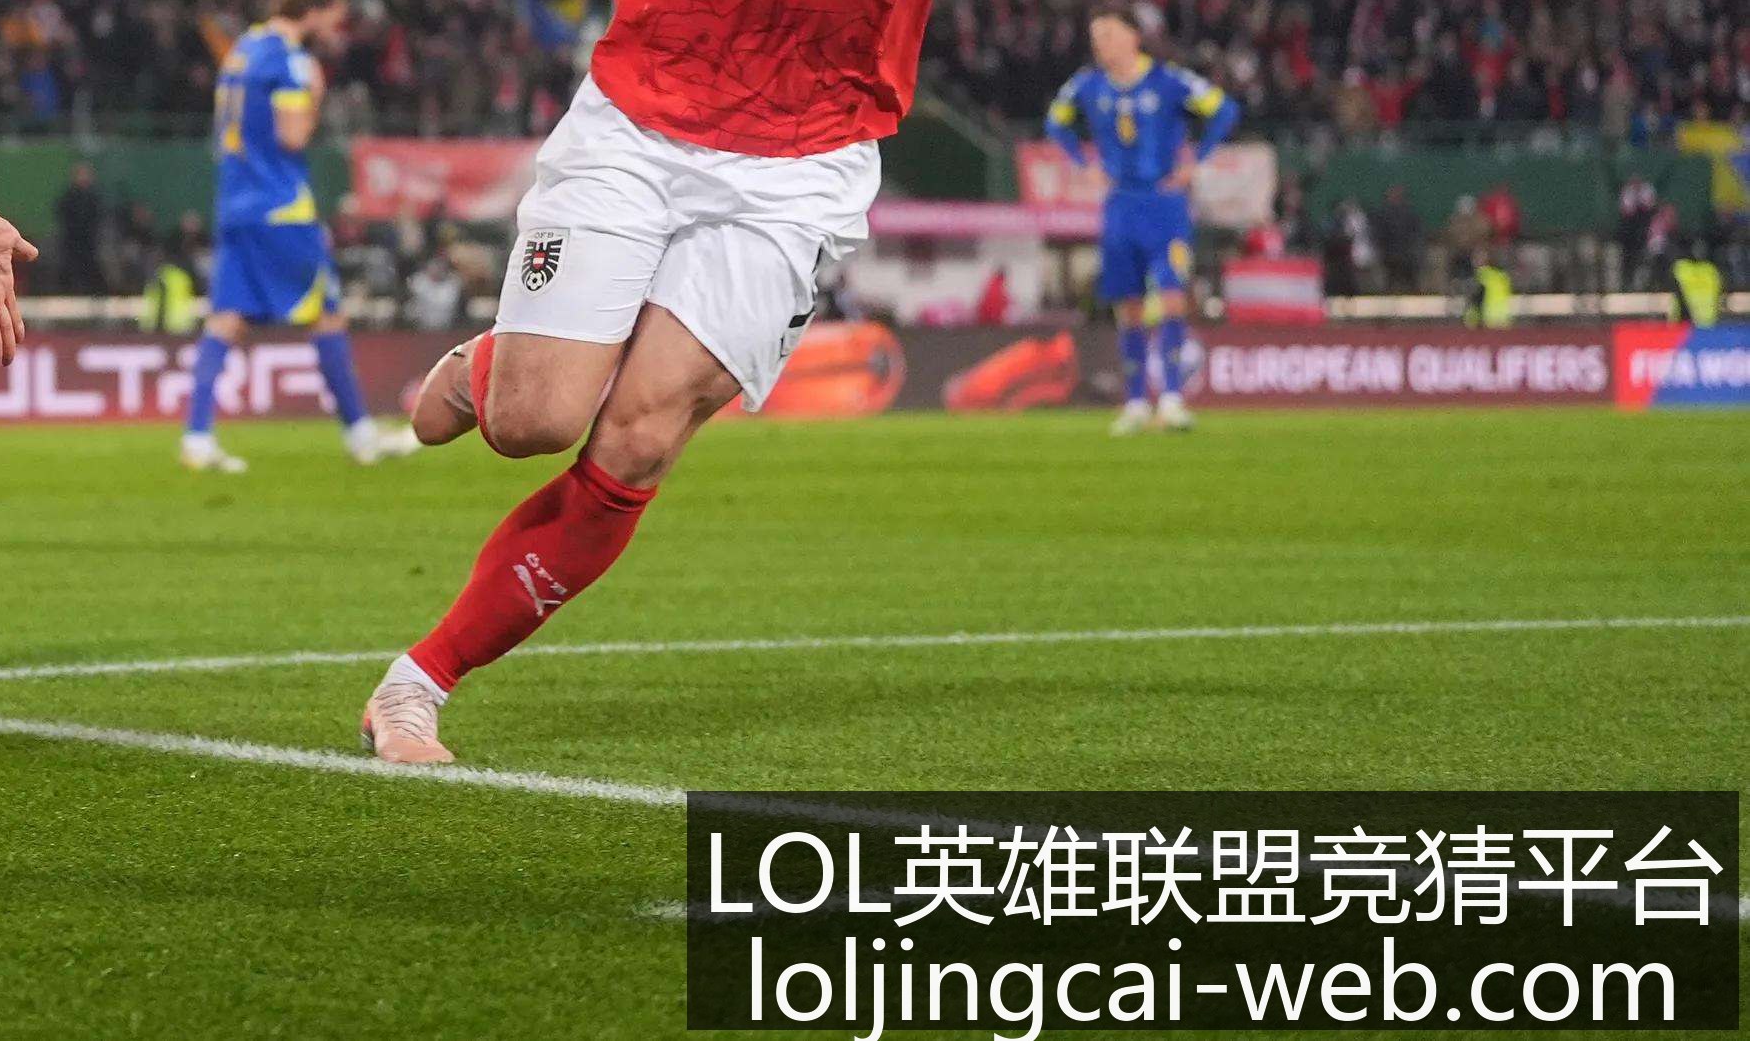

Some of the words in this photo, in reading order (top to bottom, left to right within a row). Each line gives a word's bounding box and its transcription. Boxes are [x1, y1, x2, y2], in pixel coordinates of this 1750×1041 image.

[1209, 345, 1403, 393] EUROPEAN
[1408, 345, 1607, 393] QUALIFIERS
[1630, 348, 1696, 388] FIFA
